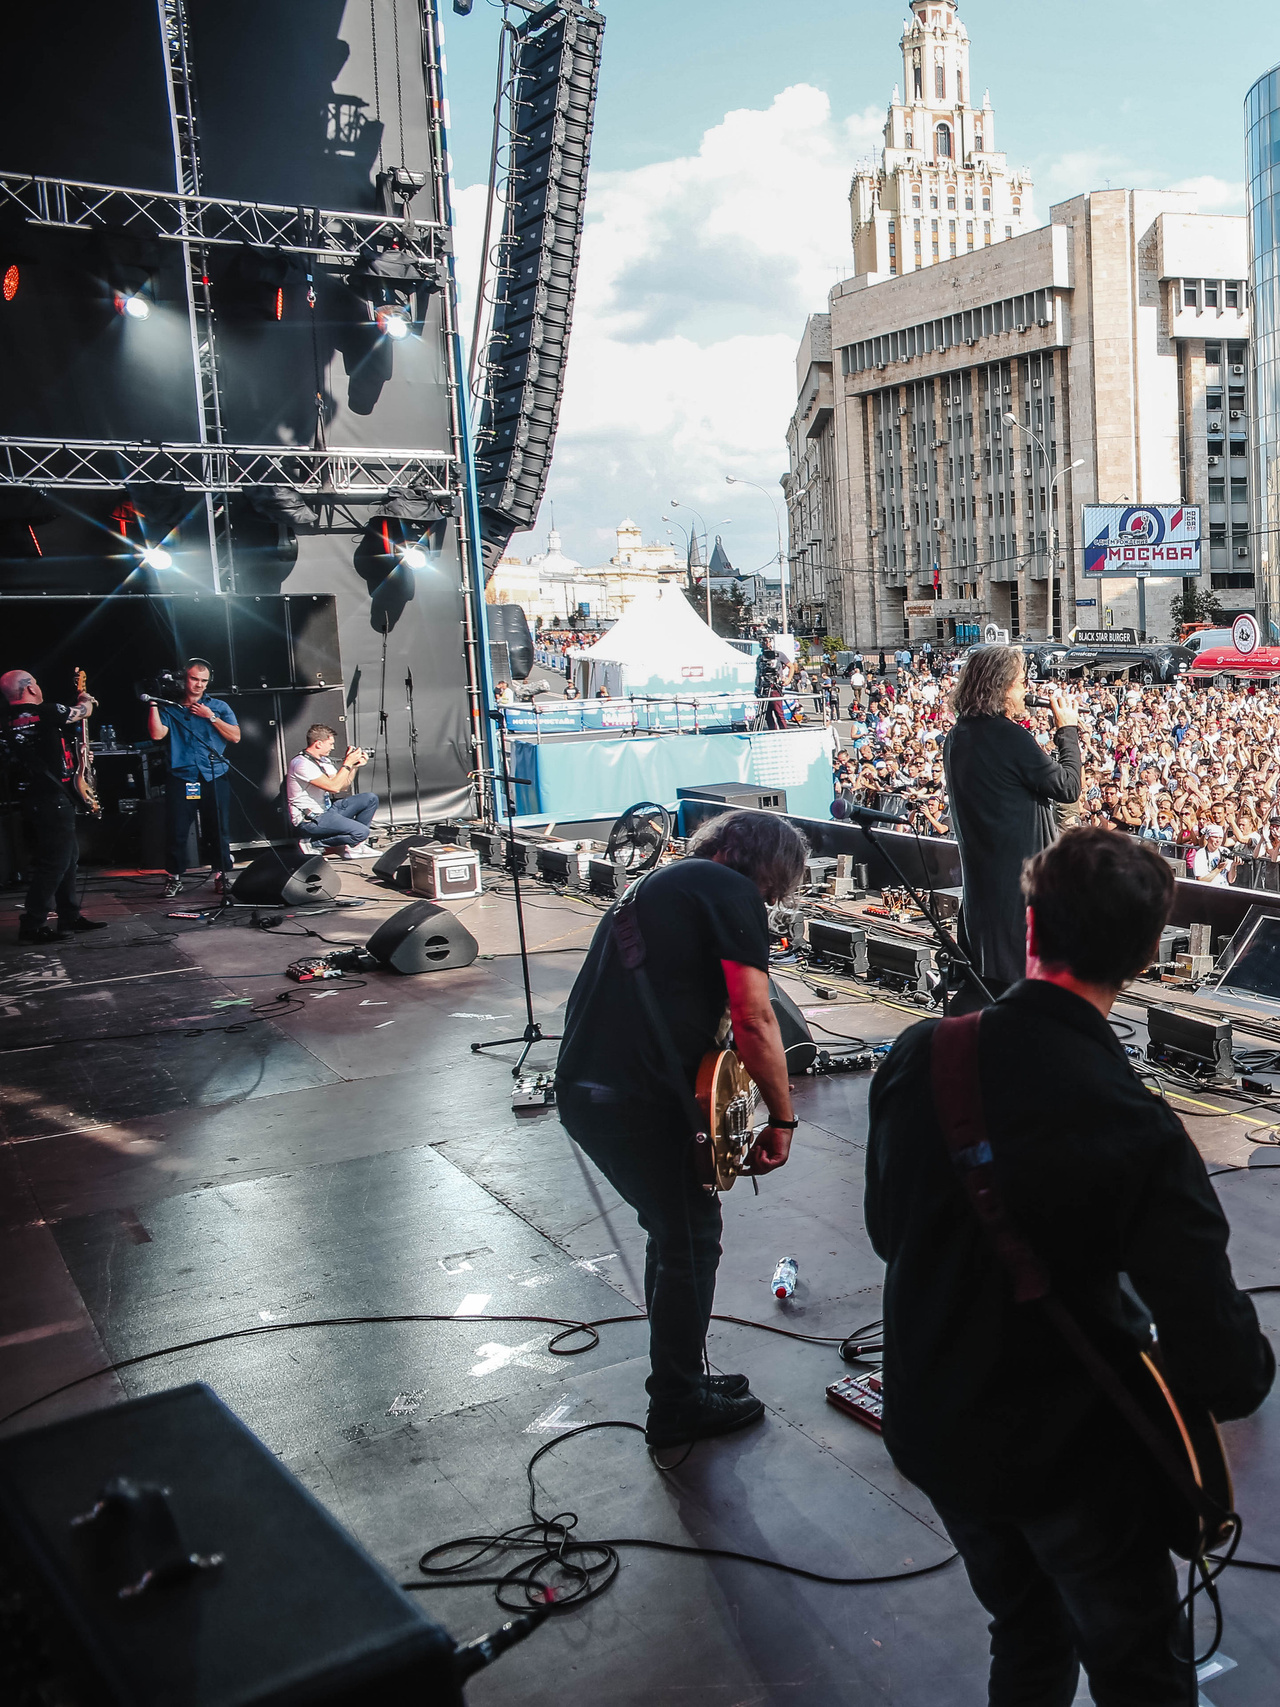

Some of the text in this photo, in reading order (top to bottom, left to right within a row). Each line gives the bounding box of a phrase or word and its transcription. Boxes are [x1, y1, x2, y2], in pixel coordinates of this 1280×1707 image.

[1109, 548, 1192, 560] МОСКВА
[1078, 632, 1131, 642] BLACK STAR BURGER
